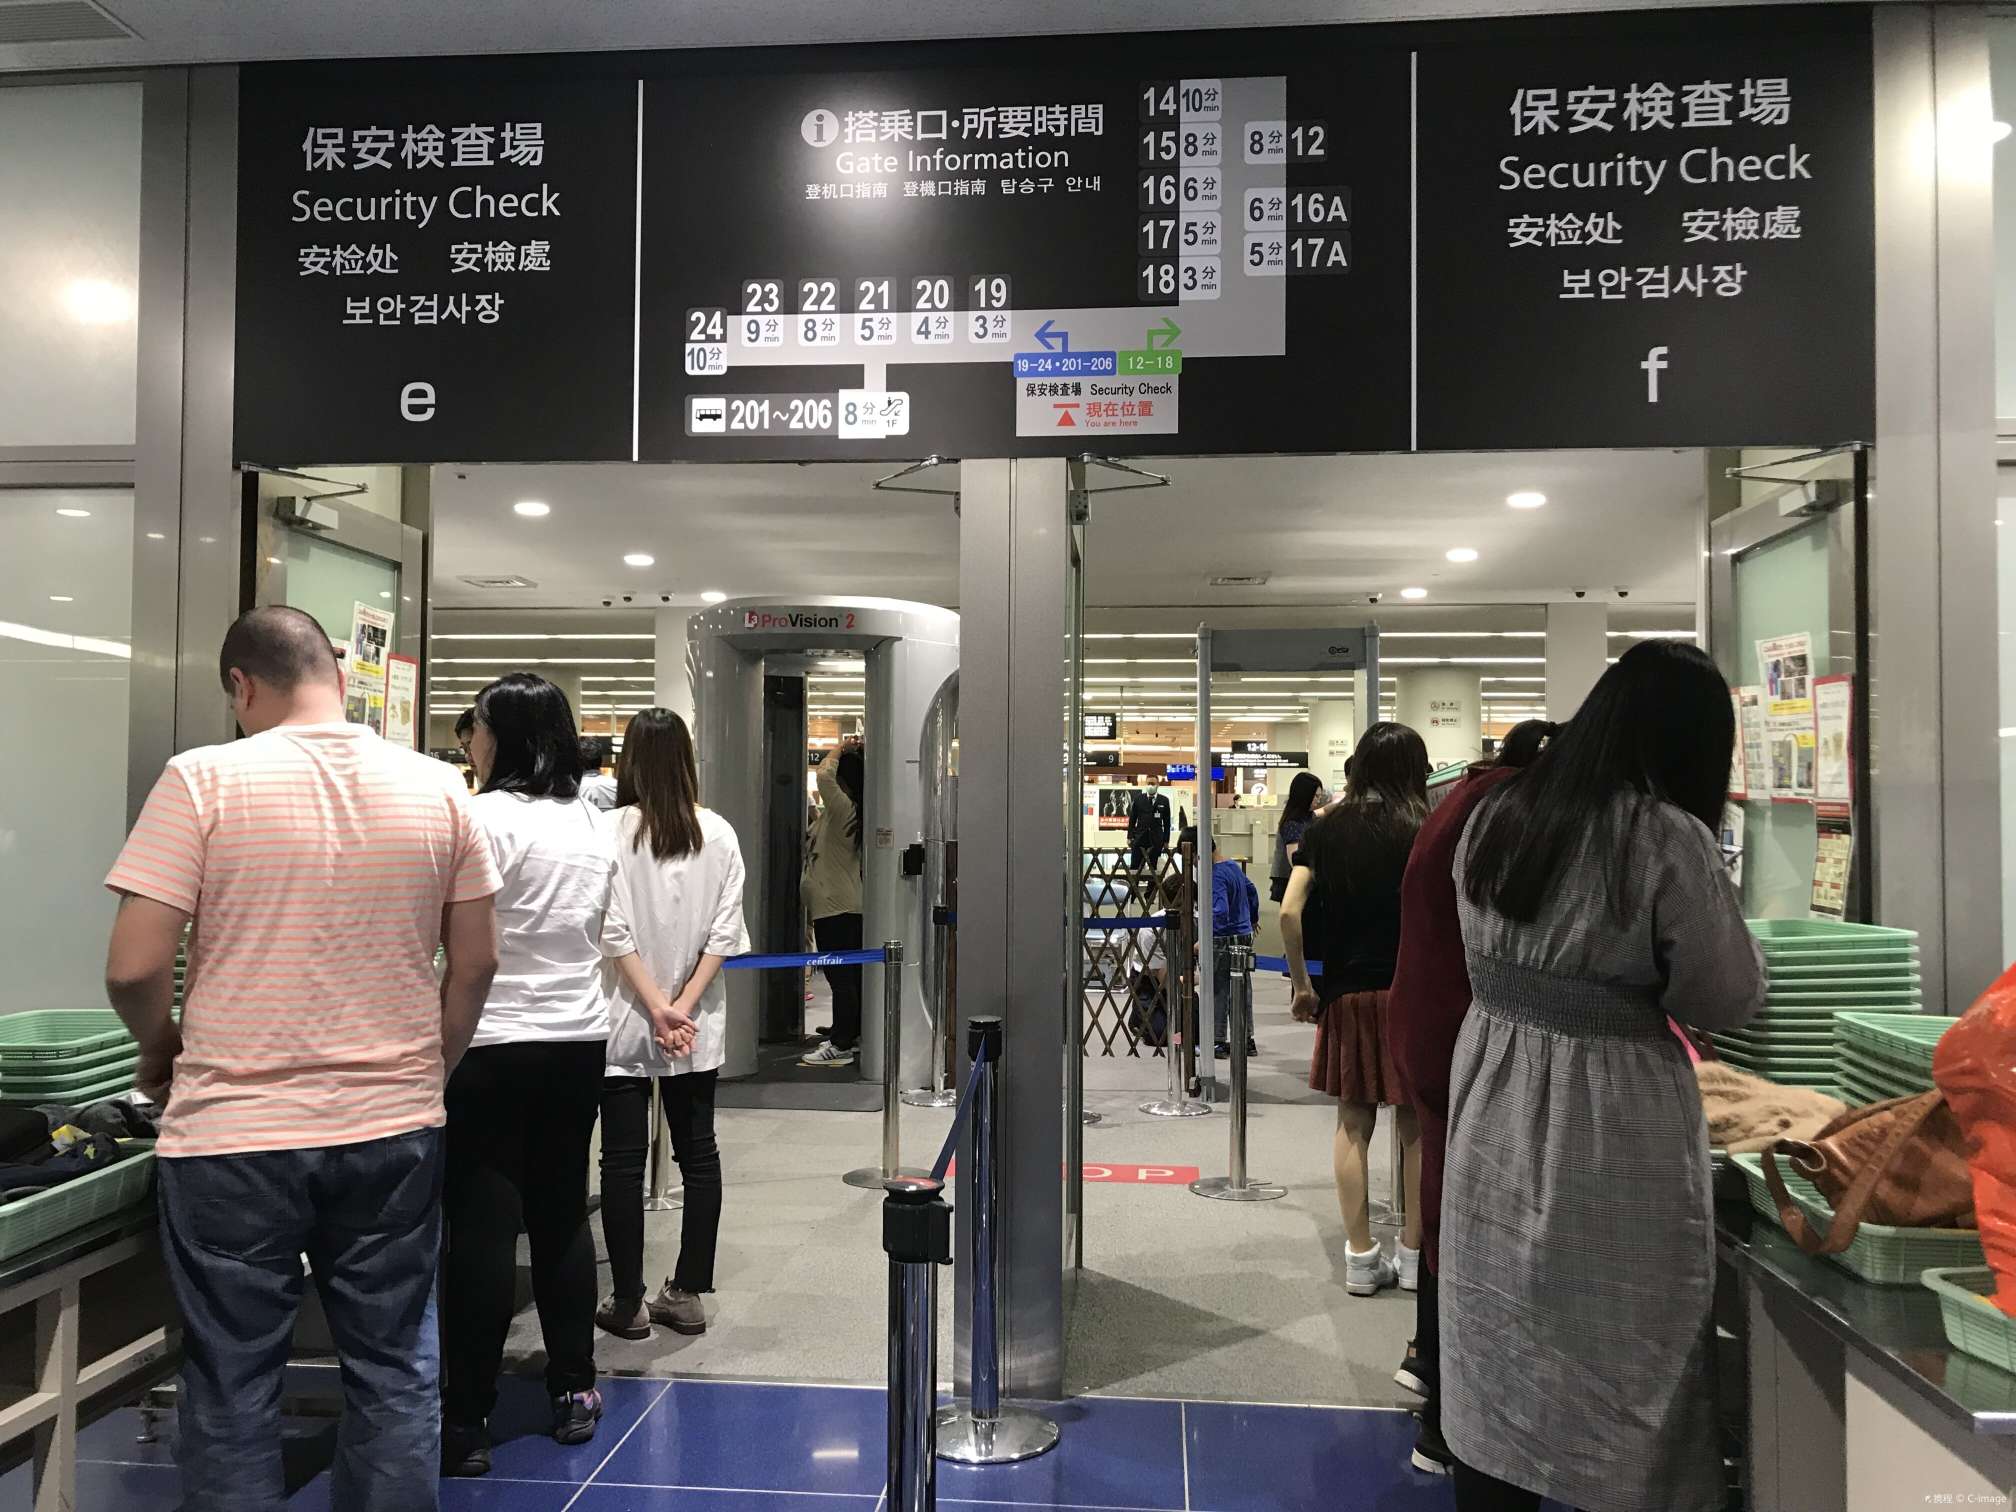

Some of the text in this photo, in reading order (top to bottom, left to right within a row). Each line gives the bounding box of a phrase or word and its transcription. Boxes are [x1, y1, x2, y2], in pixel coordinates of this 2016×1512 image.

[1144, 87, 1176, 116] 14
[1182, 88, 1202, 112] 10
[1510, 79, 1790, 136] 保安検査場
[303, 123, 544, 170] 保安検査場
[1144, 131, 1176, 160] 15
[1184, 133, 1198, 157] 8
[1250, 131, 1263, 155] 8
[1292, 126, 1324, 155] 12
[836, 146, 1069, 174] Gate Information
[1500, 144, 1811, 195] Security Check
[805, 179, 986, 200] 登机口指南 登機口指南
[1001, 176, 1100, 194] 탑승구 안내
[1143, 175, 1175, 204] 16
[1184, 177, 1198, 201] 6
[292, 184, 560, 228] Security Check
[1250, 198, 1264, 221] 6
[1292, 193, 1347, 222] 16A
[1143, 220, 1175, 249] 17
[1184, 222, 1198, 246] 5
[1508, 206, 1801, 247] 安检处 安檢處
[299, 240, 550, 275] 安检处 安檢處
[1250, 243, 1264, 266] 5
[1291, 238, 1347, 267] 17A
[975, 278, 1006, 307] 19
[1143, 265, 1174, 293] 18
[1184, 267, 1197, 290] 3
[1560, 263, 1747, 299] 보안검사장
[746, 283, 779, 312] 23
[803, 282, 835, 311] 22
[859, 281, 888, 310] 21
[916, 280, 949, 309] 20
[343, 293, 504, 325] 보안검사장
[690, 311, 723, 340] 24
[747, 320, 760, 342] 9
[804, 319, 817, 342] 8
[861, 318, 874, 341] 5
[917, 316, 931, 339] 4
[975, 315, 988, 339] 3
[688, 347, 706, 370] 10
[1129, 356, 1172, 369] 12-18
[1641, 347, 1668, 402] f
[401, 382, 435, 421] e
[1026, 382, 1172, 396] 保安検査場 Security Check
[845, 402, 857, 425] 8
[1087, 401, 1154, 417] 現在位置
[1085, 420, 1100, 428] You
[1120, 419, 1138, 428] here
[761, 613, 839, 628] ProVision
[846, 613, 855, 629] 2
[806, 956, 844, 967] centrair
